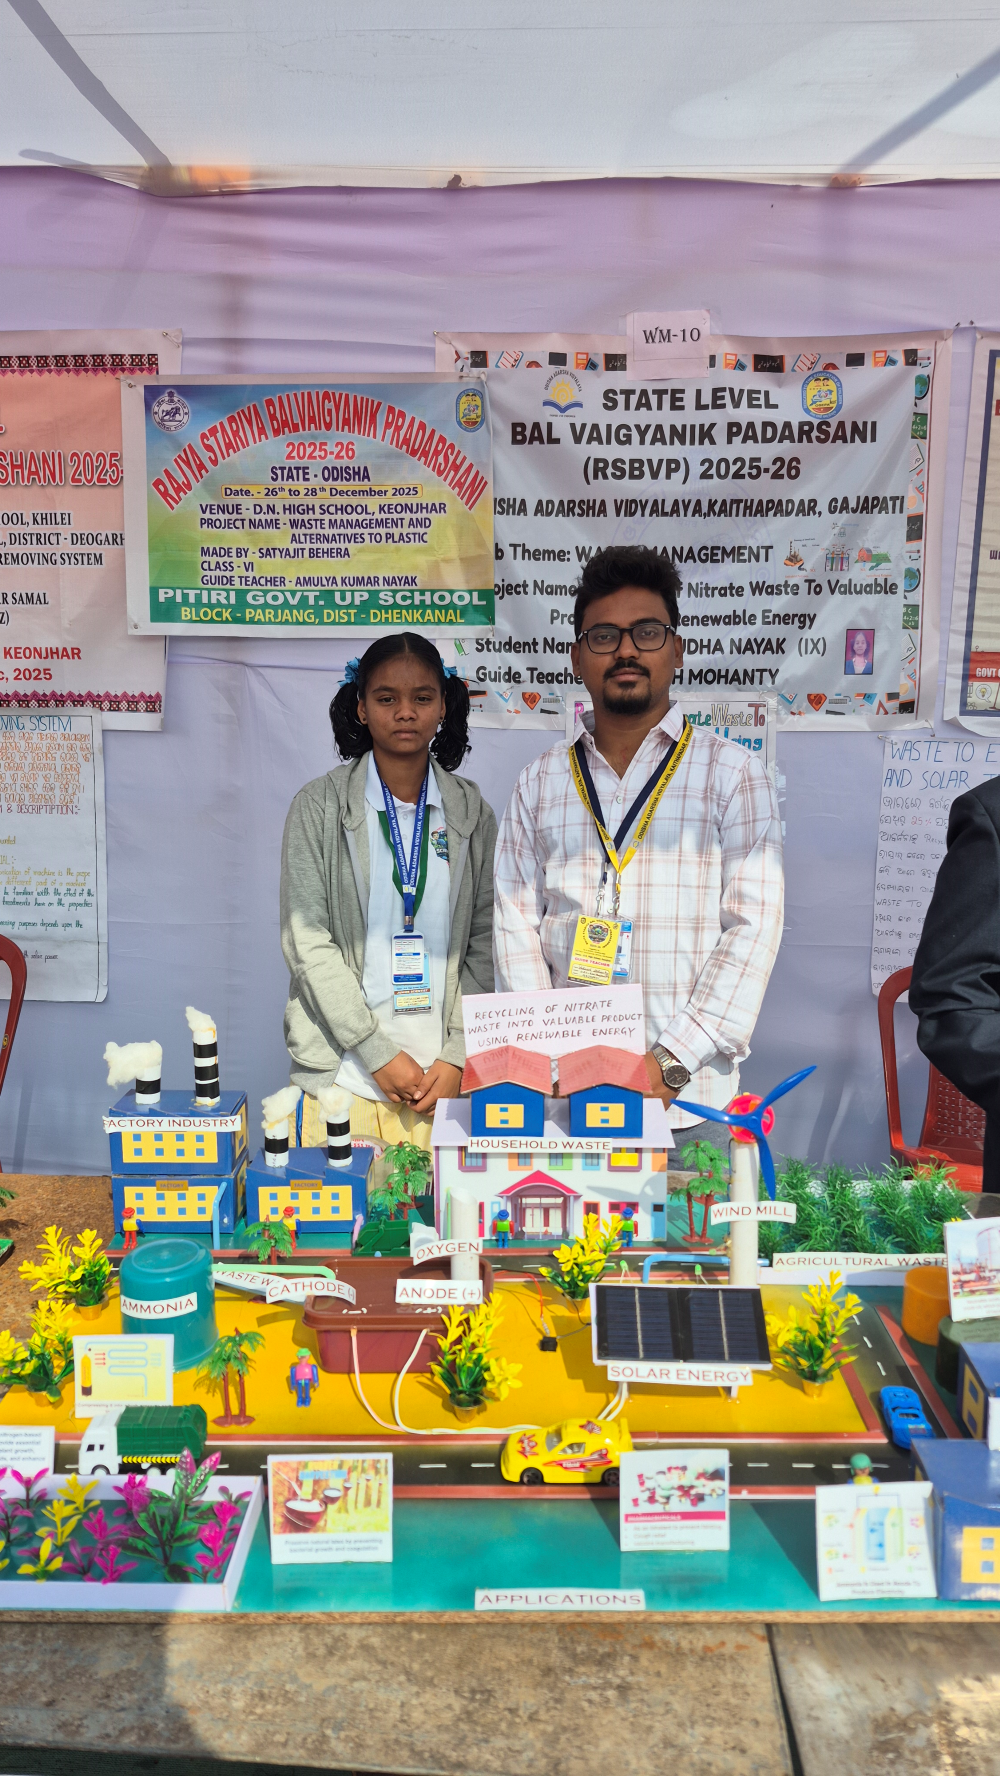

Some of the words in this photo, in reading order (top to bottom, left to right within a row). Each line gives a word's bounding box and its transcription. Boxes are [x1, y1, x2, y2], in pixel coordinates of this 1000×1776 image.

[642, 327, 700, 344] WM-10
[602, 388, 686, 411] STATE
[695, 386, 779, 410] LEVEL
[511, 421, 561, 445] BAL
[569, 422, 718, 446] VAIGYANIK
[726, 420, 877, 444] PADARSANI
[152, 443, 209, 511] RAJYA
[199, 402, 269, 467] STARIYA
[263, 390, 383, 439] BALVAIGYANIK
[379, 404, 489, 511] PRADARSHANI
[285, 440, 356, 461] 2025-26
[270, 466, 310, 482] STATE
[321, 466, 371, 482] ODISHA
[583, 456, 690, 485] (RSBVP)
[700, 456, 801, 482] 2025-26
[224, 487, 255, 497] Date.
[288, 488, 301, 497] to
[329, 487, 388, 497] December
[391, 486, 419, 497] 2025
[199, 504, 244, 516] VENUE
[253, 504, 280, 515] D.N.
[283, 504, 316, 515] HIGH
[319, 503, 375, 518] SCHOOL,
[378, 503, 447, 515] KEONJHAR
[494, 498, 528, 516] ISHA
[534, 498, 608, 518] ADARSHA
[828, 496, 905, 515] GAJAPATI
[32, 512, 72, 527] KHILEI
[200, 518, 245, 530] PROJECT
[249, 518, 280, 530] NAME
[289, 518, 326, 530] WASTE
[328, 518, 405, 529] MANAGEMENT
[408, 517, 432, 529] AND
[9, 532, 61, 546] DISTRICT
[290, 532, 366, 544] ALTERNATIVES
[368, 532, 382, 544] TO
[385, 532, 428, 544] PLASTIC
[60, 552, 103, 566] SYSTEM
[200, 547, 234, 558] MADE
[236, 547, 249, 558] BY
[258, 547, 305, 559] SATYAJIT
[307, 548, 350, 559] BEHERA
[509, 543, 571, 562] Theme:
[200, 561, 234, 572] CLASS
[243, 562, 254, 572] VI
[200, 575, 235, 586] GUIDE
[238, 576, 286, 587] TEACHER
[295, 576, 338, 587] AMULYA
[340, 576, 380, 587] KUMAR
[382, 576, 418, 587] NAYAK
[494, 579, 529, 600] oject
[688, 582, 744, 599] Nitrate
[749, 580, 799, 596] Waste
[804, 579, 822, 596] To
[827, 578, 898, 596] Valuable
[12, 592, 49, 605] SAMAL
[158, 590, 236, 606] PITIRI
[246, 591, 325, 606] GOVT.
[335, 591, 369, 606] UP
[378, 590, 487, 606] SCHOOL
[181, 607, 230, 621] BLOCK
[245, 608, 319, 625] PARJANG,
[324, 609, 357, 623] DIST
[370, 609, 464, 623] DHENKANAL
[762, 609, 817, 630] Energy
[4, 647, 82, 660] KEONJHAR
[475, 636, 540, 654] Student
[735, 637, 787, 655] NAYAK
[797, 636, 827, 657] (IX)
[13, 668, 52, 681] 2025
[476, 666, 521, 684] Guide
[526, 667, 583, 685] Teache
[688, 668, 780, 685] MOHANTY
[976, 667, 997, 678] GOVT
[711, 703, 753, 727] Waste
[748, 703, 766, 728] To
[30, 716, 71, 732] SYSTEM
[891, 740, 949, 763] WASTE
[954, 741, 975, 762] TO
[883, 769, 912, 788] AND
[920, 770, 971, 790] SOLAR
[876, 899, 902, 907] WASTE
[906, 899, 922, 908] TO
[589, 958, 610, 967] TEACHER
[475, 1006, 535, 1020] RECYCLING
[545, 1004, 558, 1014] OF
[564, 1000, 613, 1012] NITRATE
[467, 1022, 501, 1035] WASTE
[507, 1019, 534, 1029] INTO
[542, 1015, 596, 1027] VALUABLE
[601, 1013, 643, 1023] PRODUCT
[477, 1035, 509, 1048] USING
[516, 1029, 582, 1042] RENEWABLE
[592, 1027, 636, 1038] ENERGY
[168, 1117, 237, 1128] INDUSTRY
[470, 1139, 558, 1150] HOUSEHOLD
[562, 1141, 611, 1151] WASTE
[416, 1242, 479, 1260] OXYGEN
[775, 1257, 893, 1267] AGRICULTURAL
[897, 1257, 948, 1267] WASTE
[268, 1281, 345, 1298] CATHODE
[399, 1287, 458, 1299] ANODE
[462, 1287, 481, 1300] (+)
[122, 1298, 194, 1315] AMMONIA
[610, 1366, 671, 1380] SOLAR
[676, 1369, 750, 1383] ENERGY
[480, 1594, 641, 1606] APPLICATIONS
